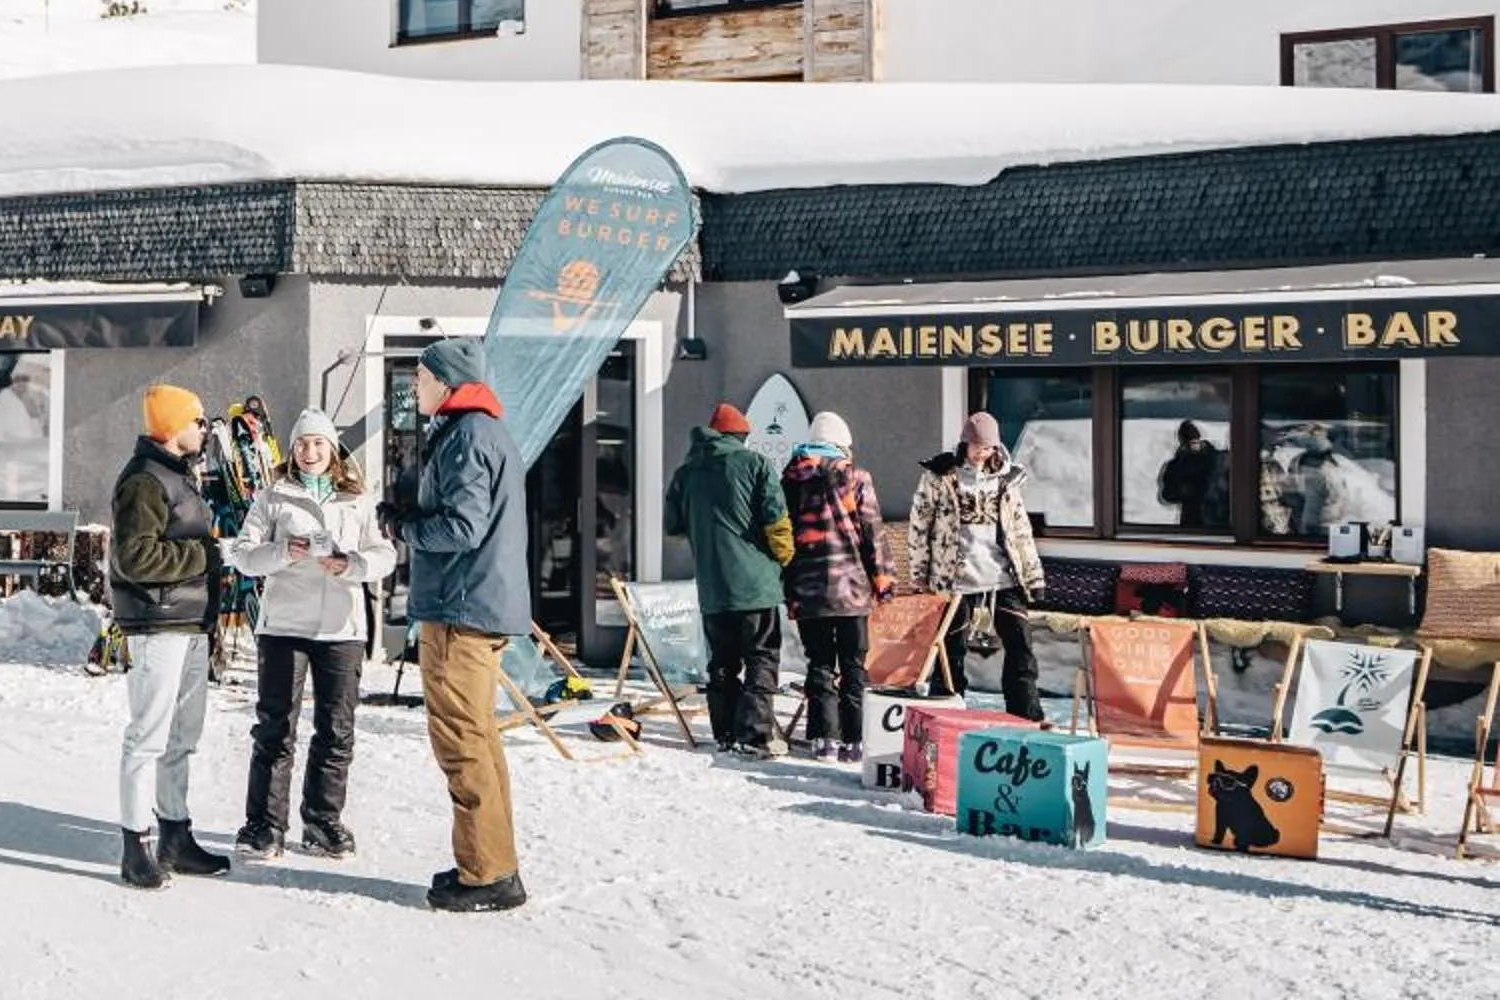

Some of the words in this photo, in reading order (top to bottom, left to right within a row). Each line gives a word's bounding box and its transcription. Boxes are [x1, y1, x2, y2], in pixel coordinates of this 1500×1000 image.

[565, 196, 599, 215] WE
[610, 201, 678, 228] SURF
[558, 218, 668, 251] BURGER
[829, 321, 1054, 358] MAIENSEE
[1092, 314, 1302, 354] BURGER
[1342, 309, 1460, 350] BAR
[1111, 627, 1171, 641] GOOD
[974, 741, 1051, 786] Cafe
[994, 784, 1018, 813] &
